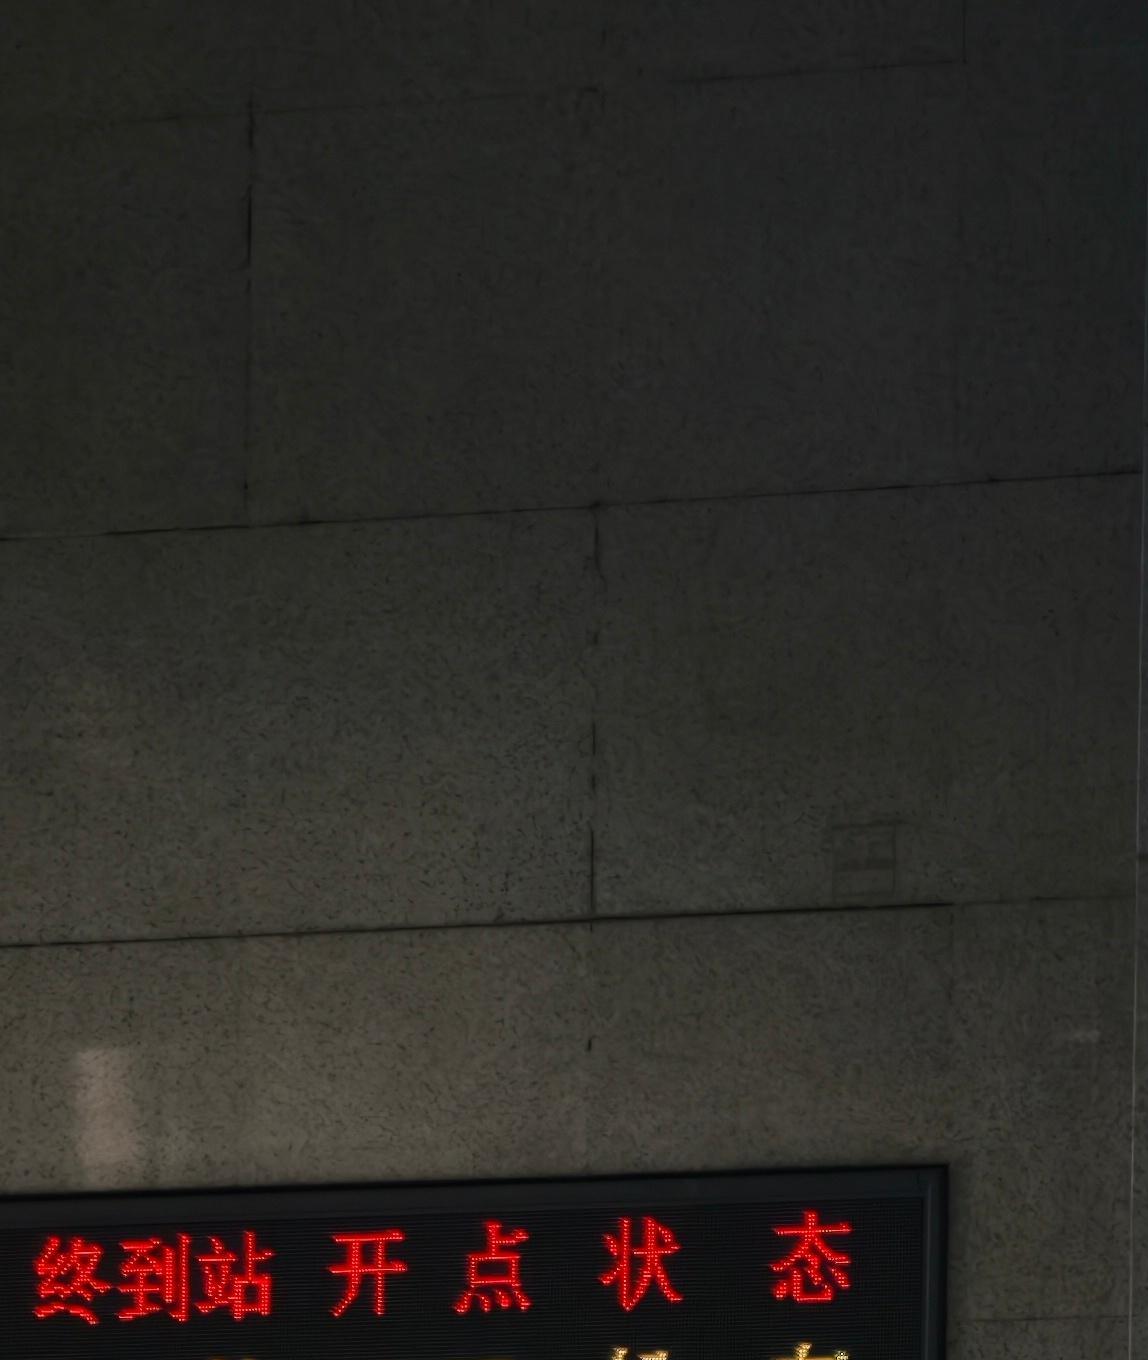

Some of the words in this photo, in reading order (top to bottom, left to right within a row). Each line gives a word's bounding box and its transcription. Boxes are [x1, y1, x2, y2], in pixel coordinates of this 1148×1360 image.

[33, 1230, 274, 1326] 终到站
[330, 1221, 532, 1317] 开点
[600, 1210, 853, 1312] 状态
